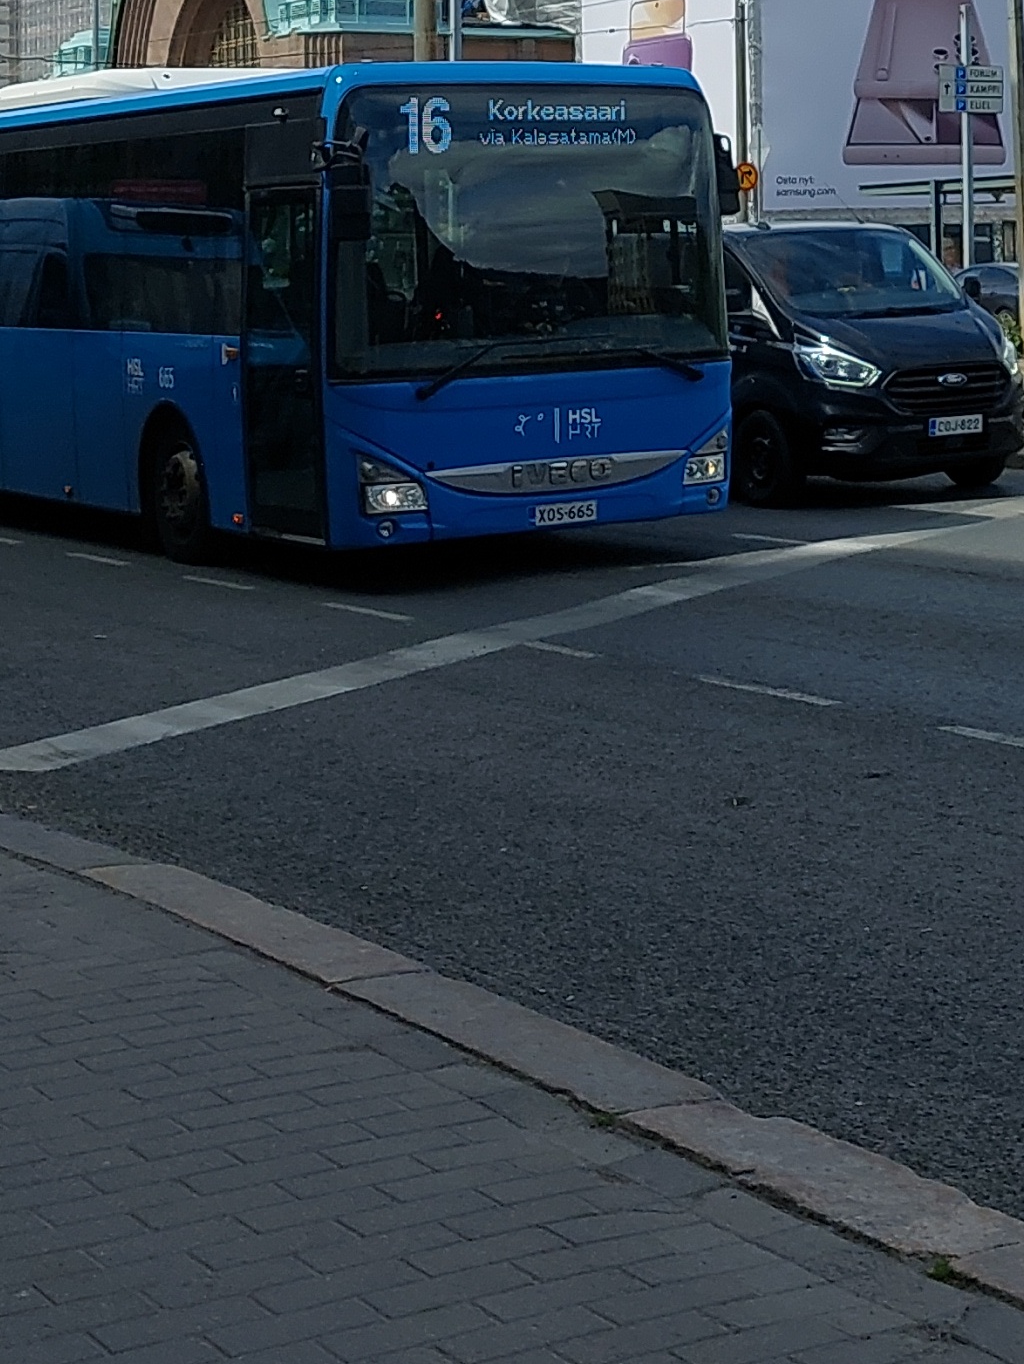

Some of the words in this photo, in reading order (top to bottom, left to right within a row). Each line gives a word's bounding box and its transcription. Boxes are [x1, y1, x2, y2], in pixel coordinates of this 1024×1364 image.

[489, 99, 625, 122] Korkeasaari
[400, 97, 452, 154] 16
[480, 129, 505, 146] via
[511, 128, 636, 146] Kalasatama(M)
[568, 408, 602, 424] HSL
[568, 423, 602, 439] HRT
[511, 457, 612, 489] IVECO
[538, 504, 594, 523] XOS-665
